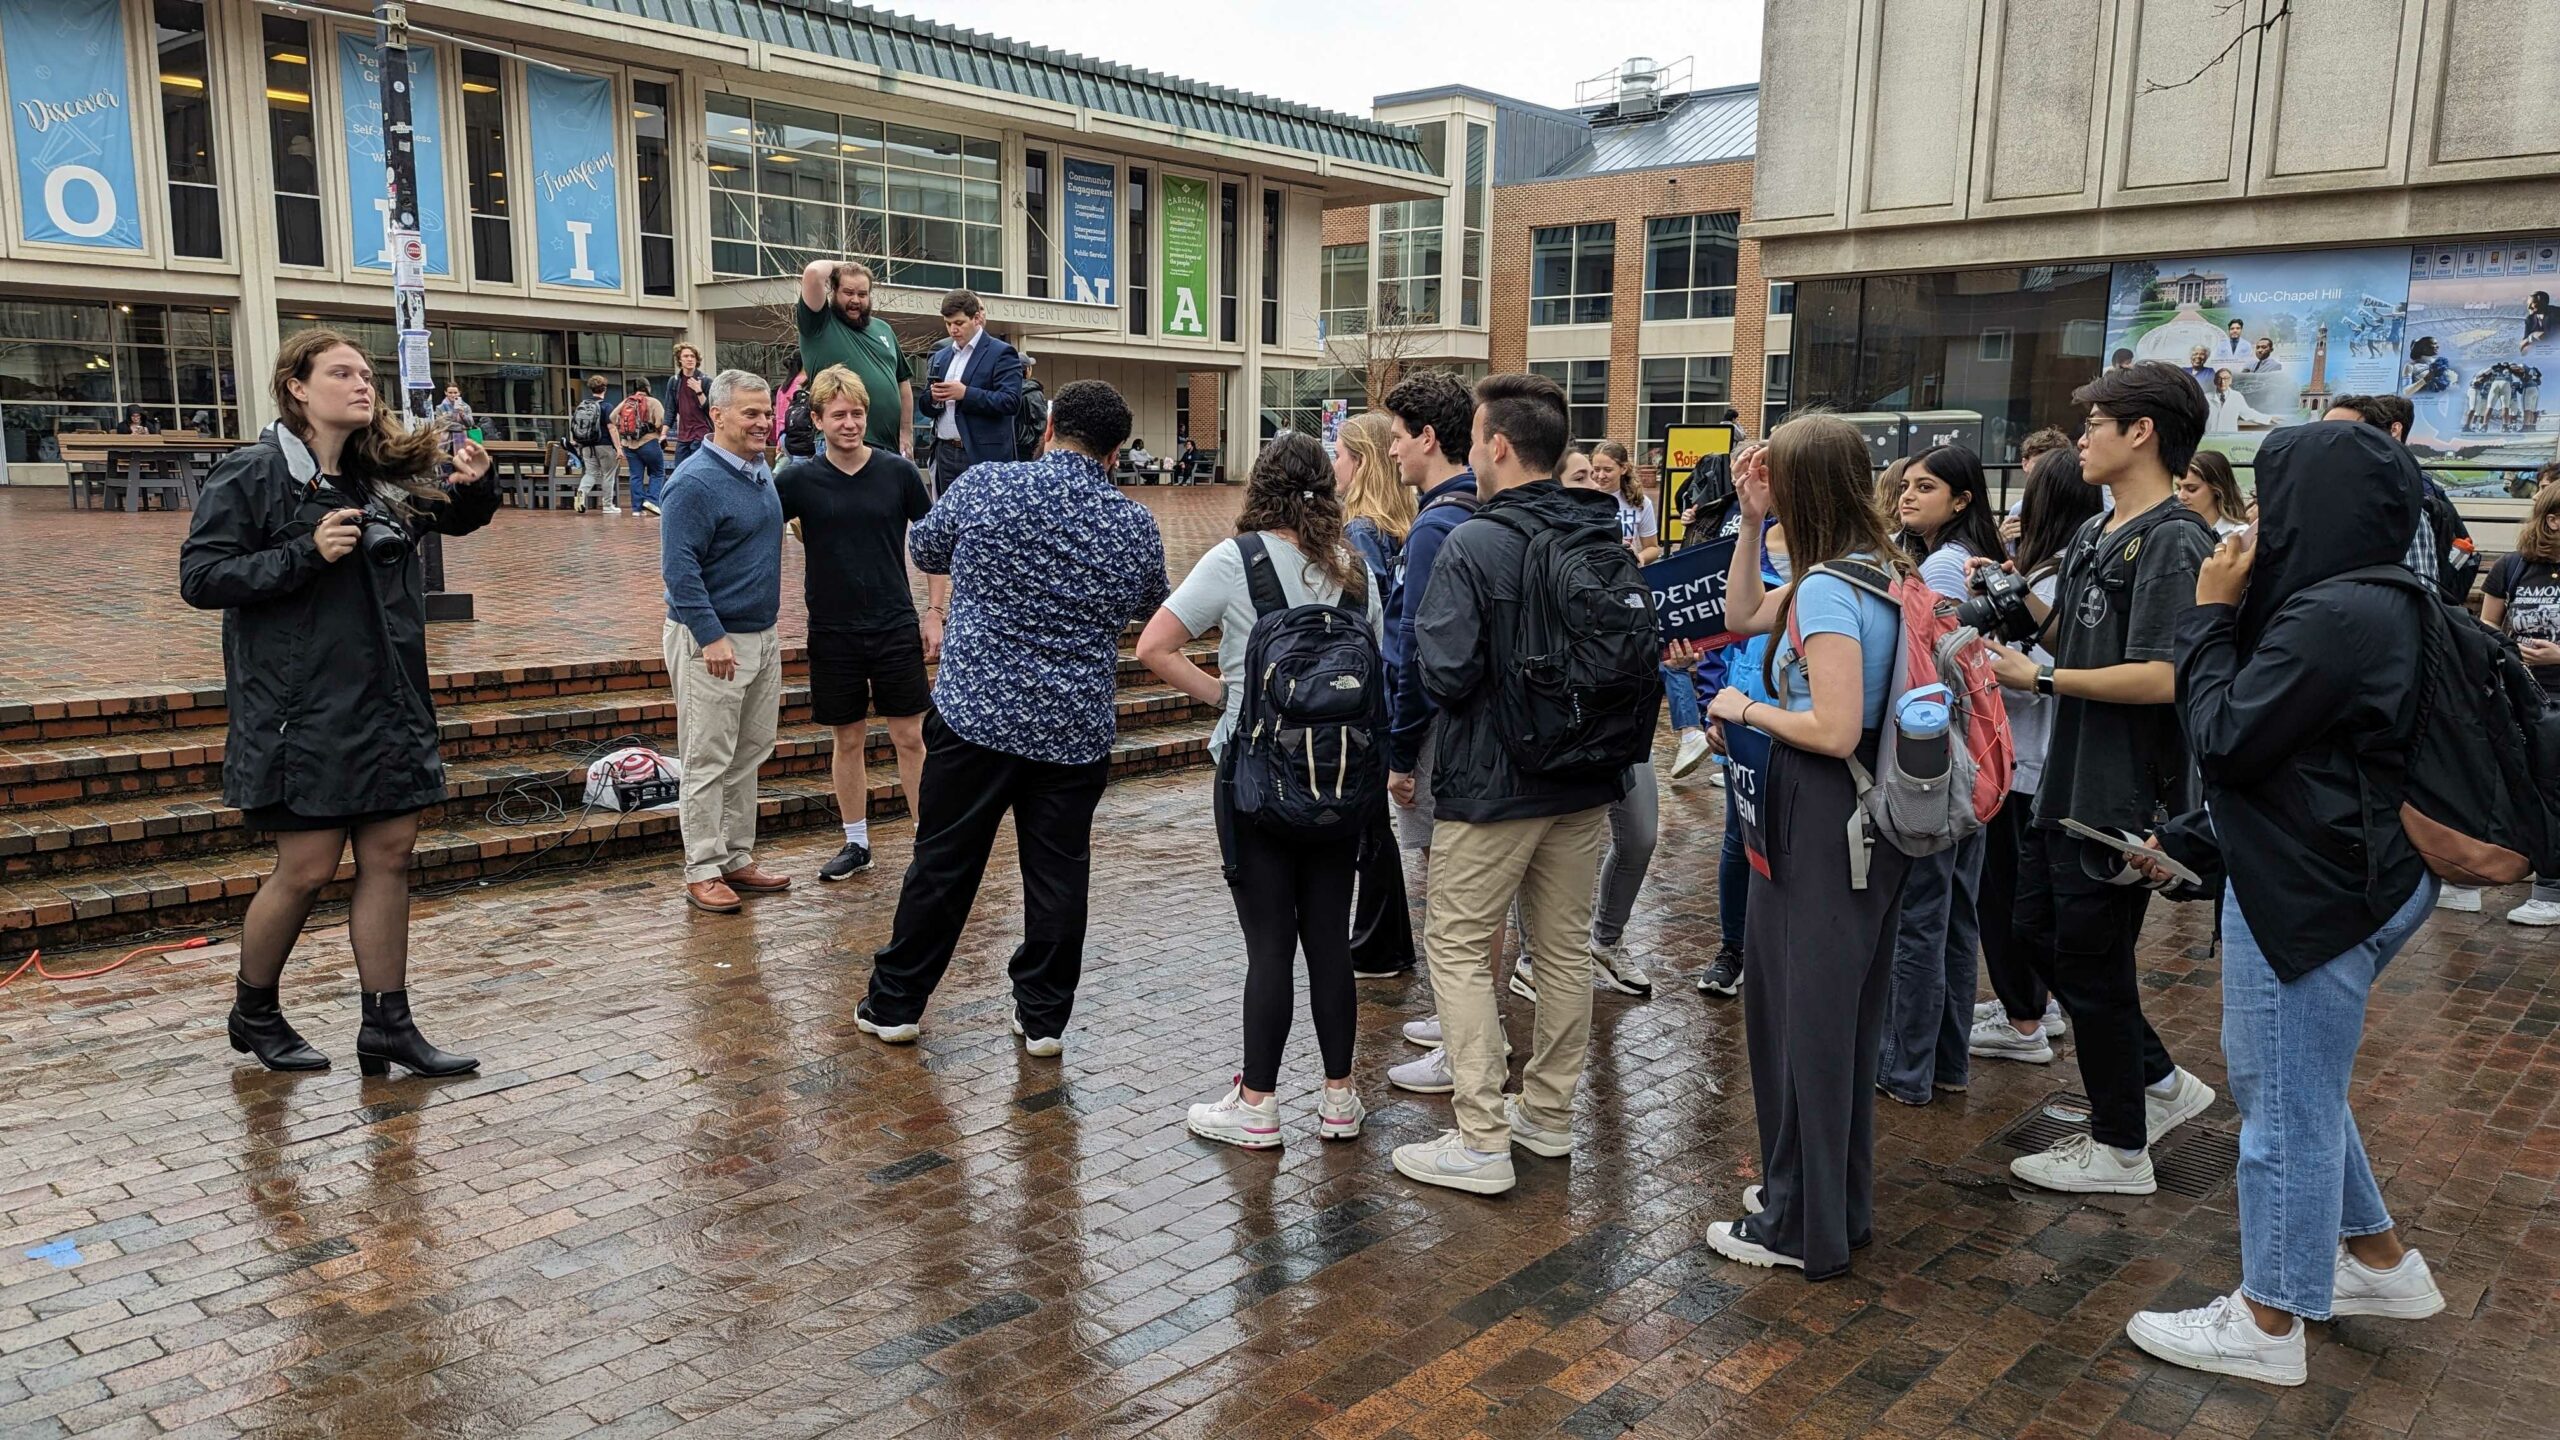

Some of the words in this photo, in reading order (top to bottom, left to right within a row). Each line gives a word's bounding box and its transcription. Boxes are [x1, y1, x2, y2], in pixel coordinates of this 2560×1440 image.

[19, 88, 119, 133] Discover
[535, 151, 615, 202] Transform
[1067, 182, 1113, 198] Engagement
[1068, 171, 1112, 189] Community
[45, 165, 117, 238] O
[1167, 196, 1205, 212] CAROLINA
[566, 220, 595, 281] I
[871, 289, 925, 310] ORTER
[1003, 304, 1065, 321] STUDENT
[1069, 309, 1110, 325] UNION
[1073, 275, 1110, 305] N
[2238, 290, 2318, 304] UNC-Chapel
[2321, 288, 2343, 301] Hill
[1169, 286, 1203, 333] A
